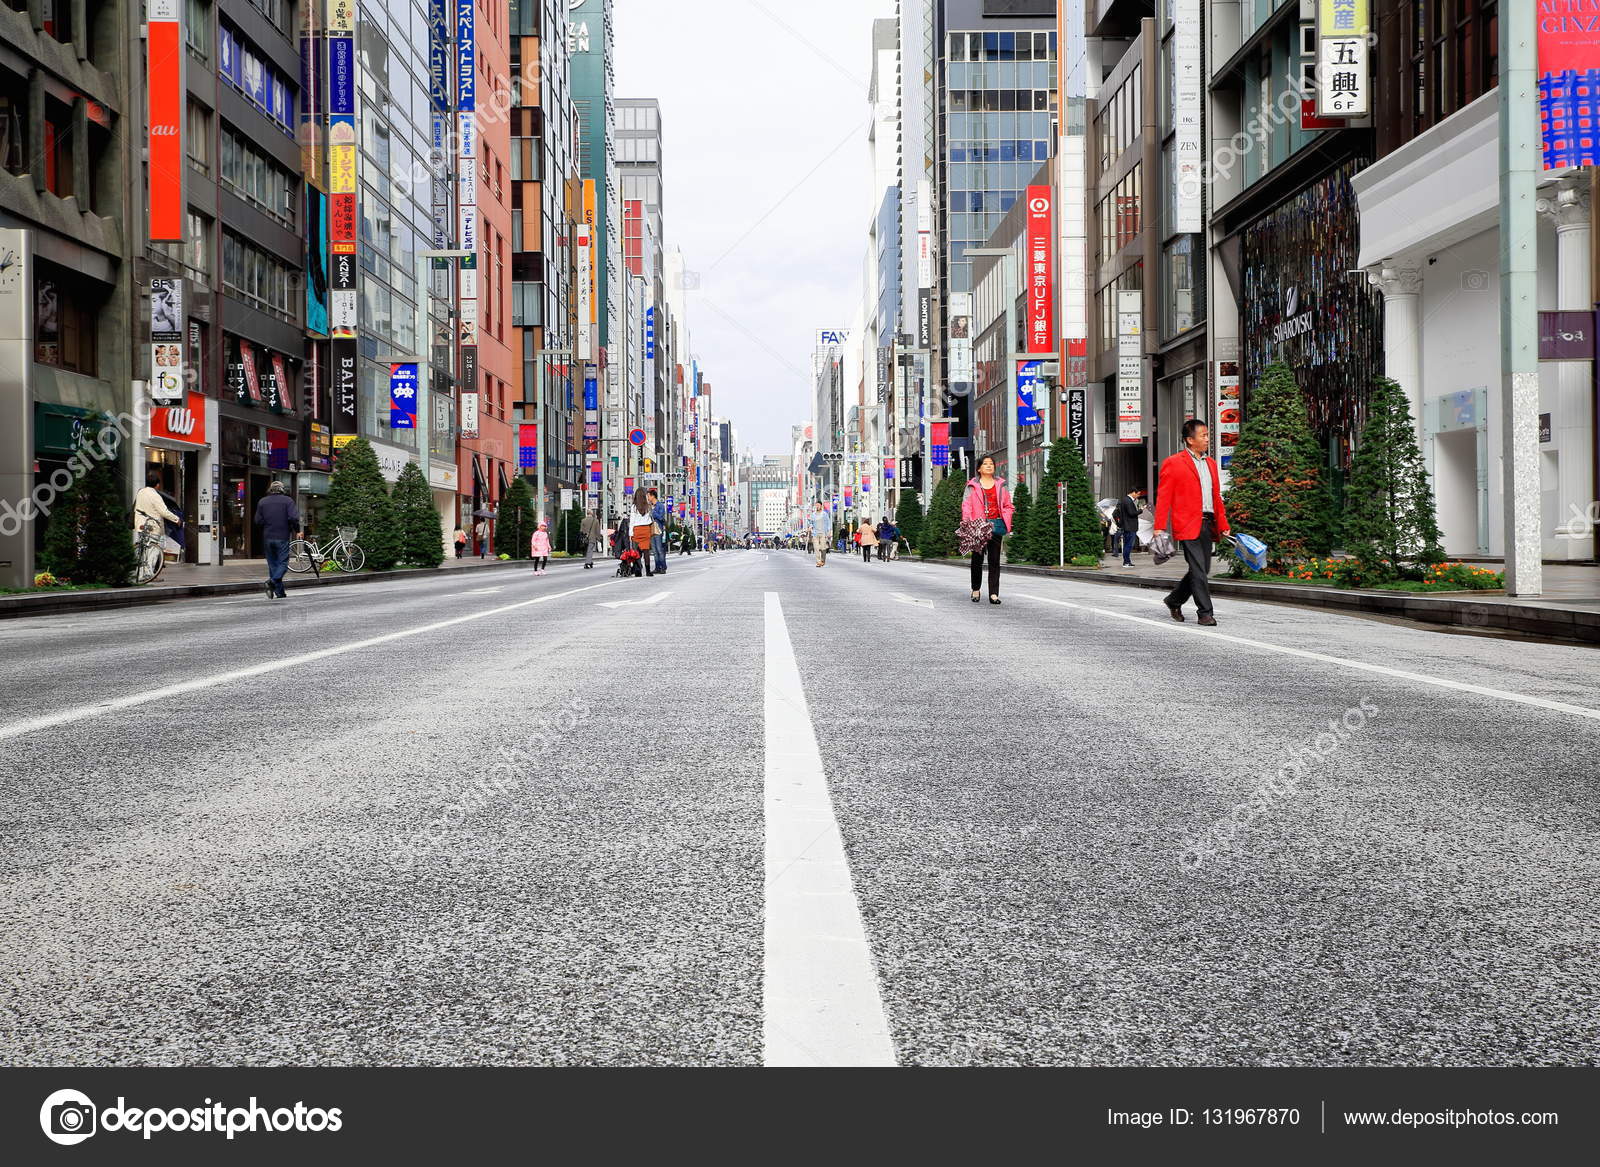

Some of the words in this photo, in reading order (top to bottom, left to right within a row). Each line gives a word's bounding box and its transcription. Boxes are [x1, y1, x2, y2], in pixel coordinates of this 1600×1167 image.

[1542, 16, 1600, 34] GINZ
[461, 4, 472, 101] スペーストラスト
[1330, 41, 1360, 99] 五興
[152, 125, 177, 136] au
[1180, 142, 1198, 151] ZEN
[339, 256, 350, 288] KANSAI
[1033, 237, 1047, 345] 三菱東京UFJ銀行
[921, 297, 930, 340] MONTBLANC
[1273, 311, 1313, 345] SWAROVSKI
[237, 363, 245, 398] ローマイヤ
[269, 374, 277, 407] ローマイヤ
[341, 357, 355, 416] BALLY
[167, 408, 195, 435] au
[1072, 391, 1084, 462] 長崎センター
[252, 439, 273, 455] BALLY
